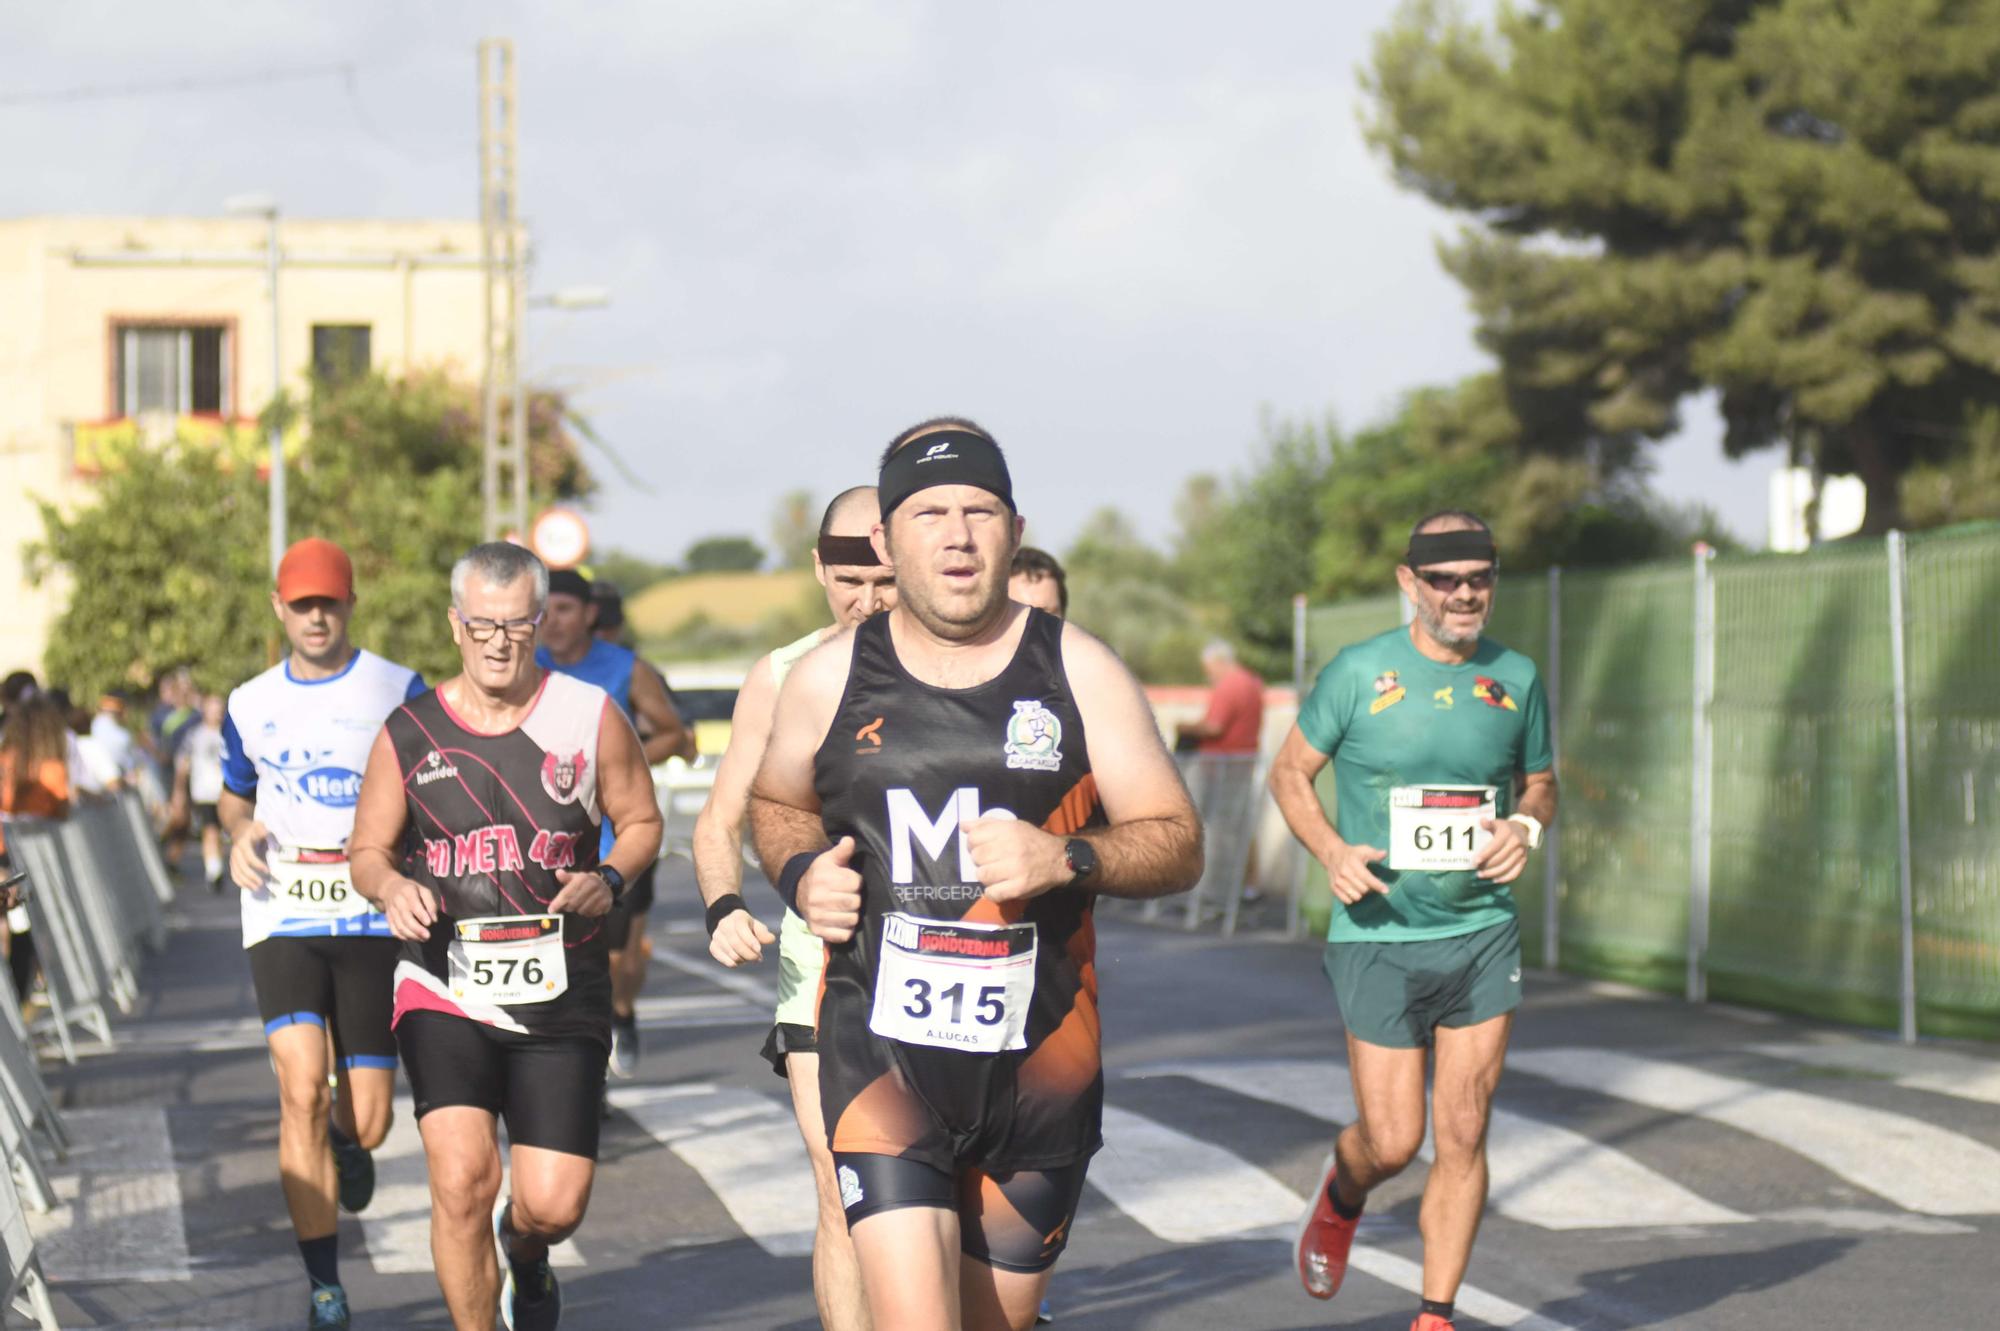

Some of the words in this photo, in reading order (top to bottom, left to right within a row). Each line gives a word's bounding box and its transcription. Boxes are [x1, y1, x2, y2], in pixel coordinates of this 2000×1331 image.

[424, 838, 450, 878] MI
[454, 824, 525, 878] META
[1414, 825, 1475, 851] 611
[288, 879, 347, 902] 406
[473, 957, 544, 986] 576
[903, 978, 1006, 1026] 315
[926, 1029, 979, 1044] A.LUCAS
